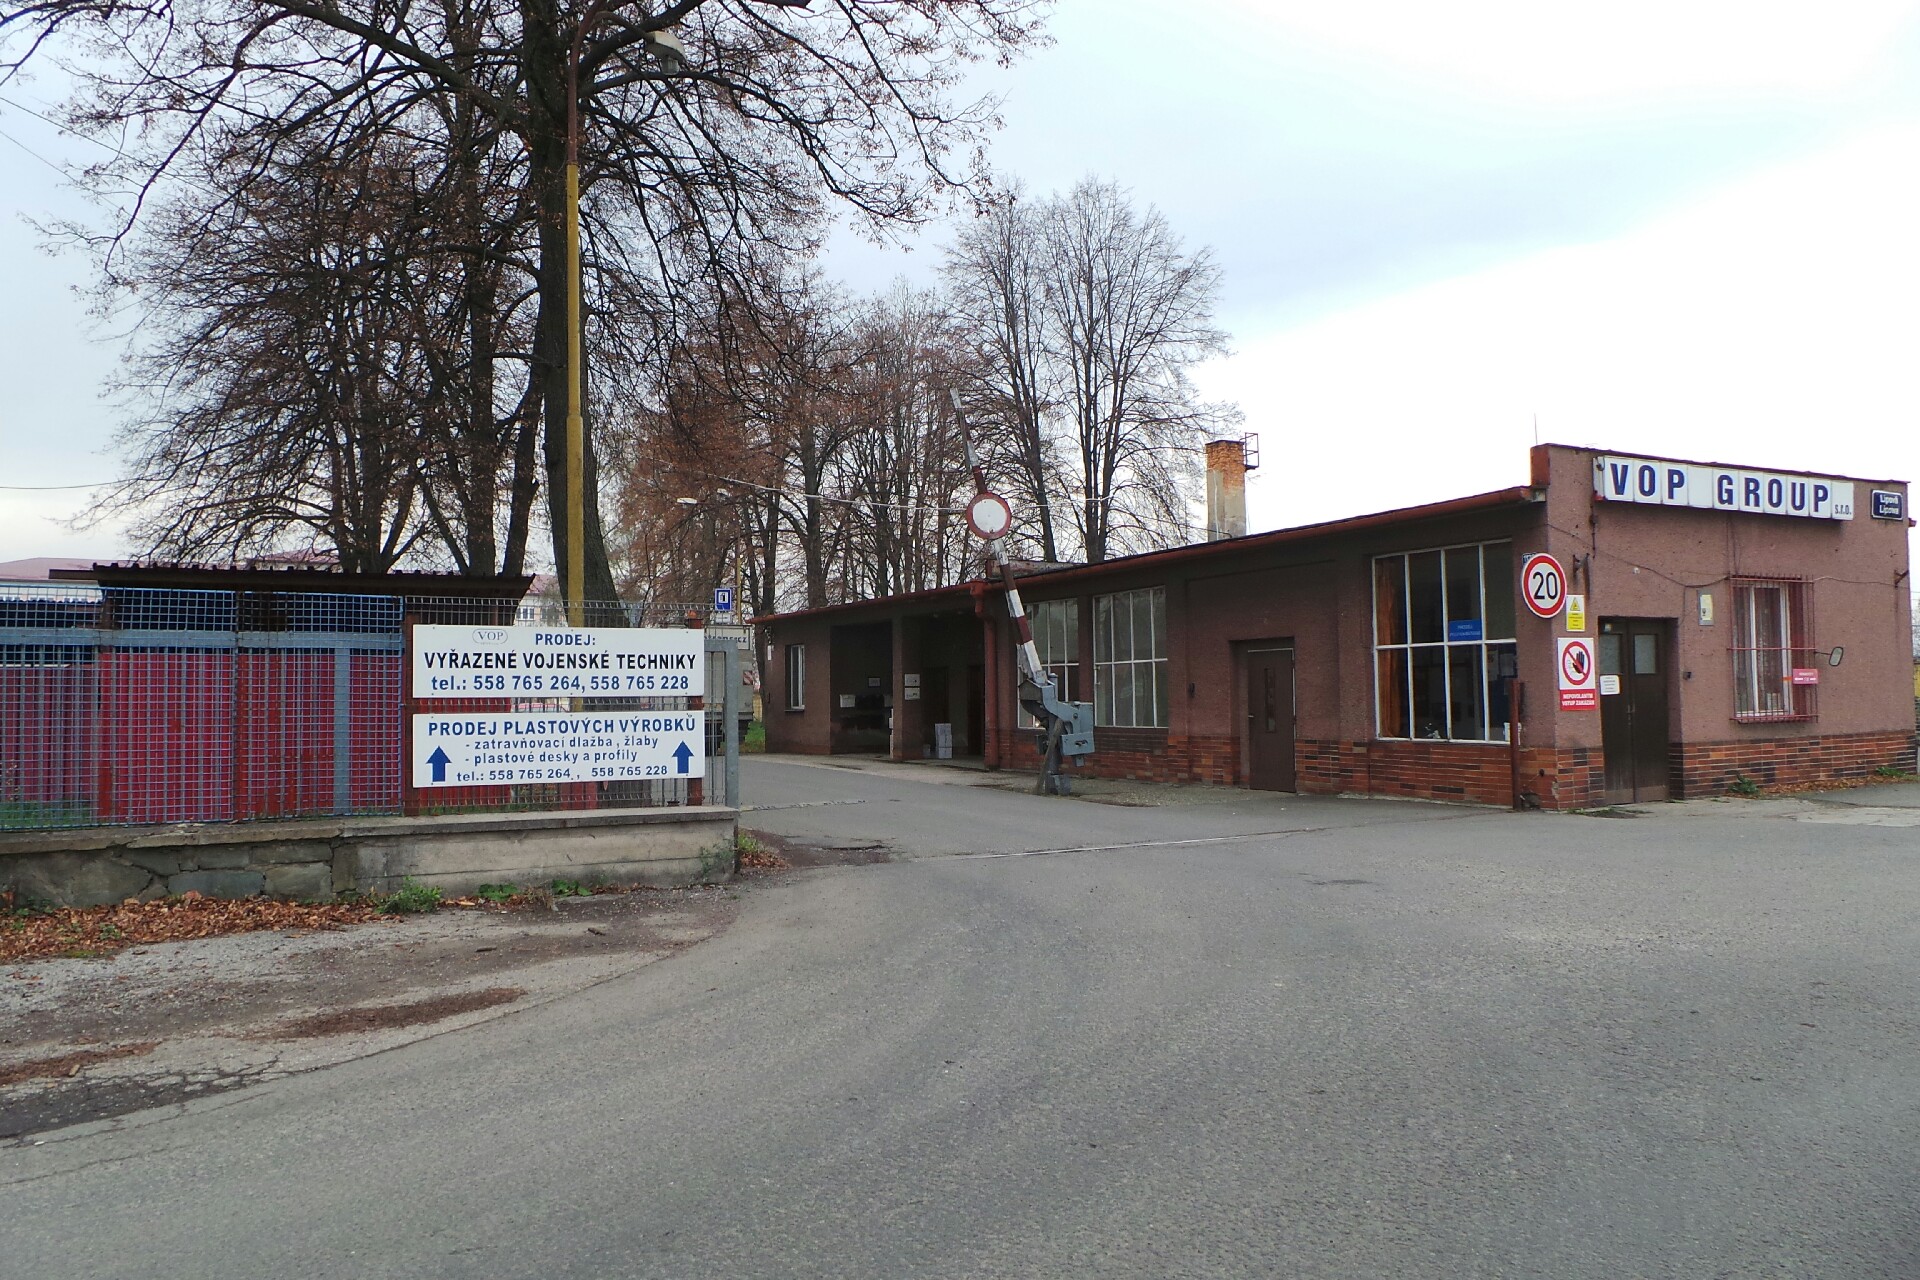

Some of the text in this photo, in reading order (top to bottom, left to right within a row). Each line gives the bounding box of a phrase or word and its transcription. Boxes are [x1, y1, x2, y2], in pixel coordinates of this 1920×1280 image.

[1610, 463, 1685, 499] VOP
[1717, 474, 1829, 513] GROUP
[1533, 571, 1558, 600] 20
[477, 631, 504, 641] VOP
[535, 633, 596, 646] PRODEJ:
[424, 648, 696, 670] VYŘAZENÉ VOJENSKÉ TECHNIKY
[431, 675, 689, 693] tel.: 558 765 264, 558 765 228
[428, 714, 695, 736] PRODEJ PLASTOVÝCH VÝROBKŮ
[474, 736, 565, 750] zatravňovací
[624, 735, 658, 749] žlaby
[474, 751, 534, 766] plastové
[539, 750, 579, 764] desky
[583, 752, 590, 761] a
[594, 749, 638, 762] profily
[457, 771, 484, 782] tel.:
[489, 770, 514, 780] 558
[519, 769, 543, 779] 765
[591, 767, 614, 777] 558
[619, 766, 642, 776] 765
[645, 765, 668, 775] 228
